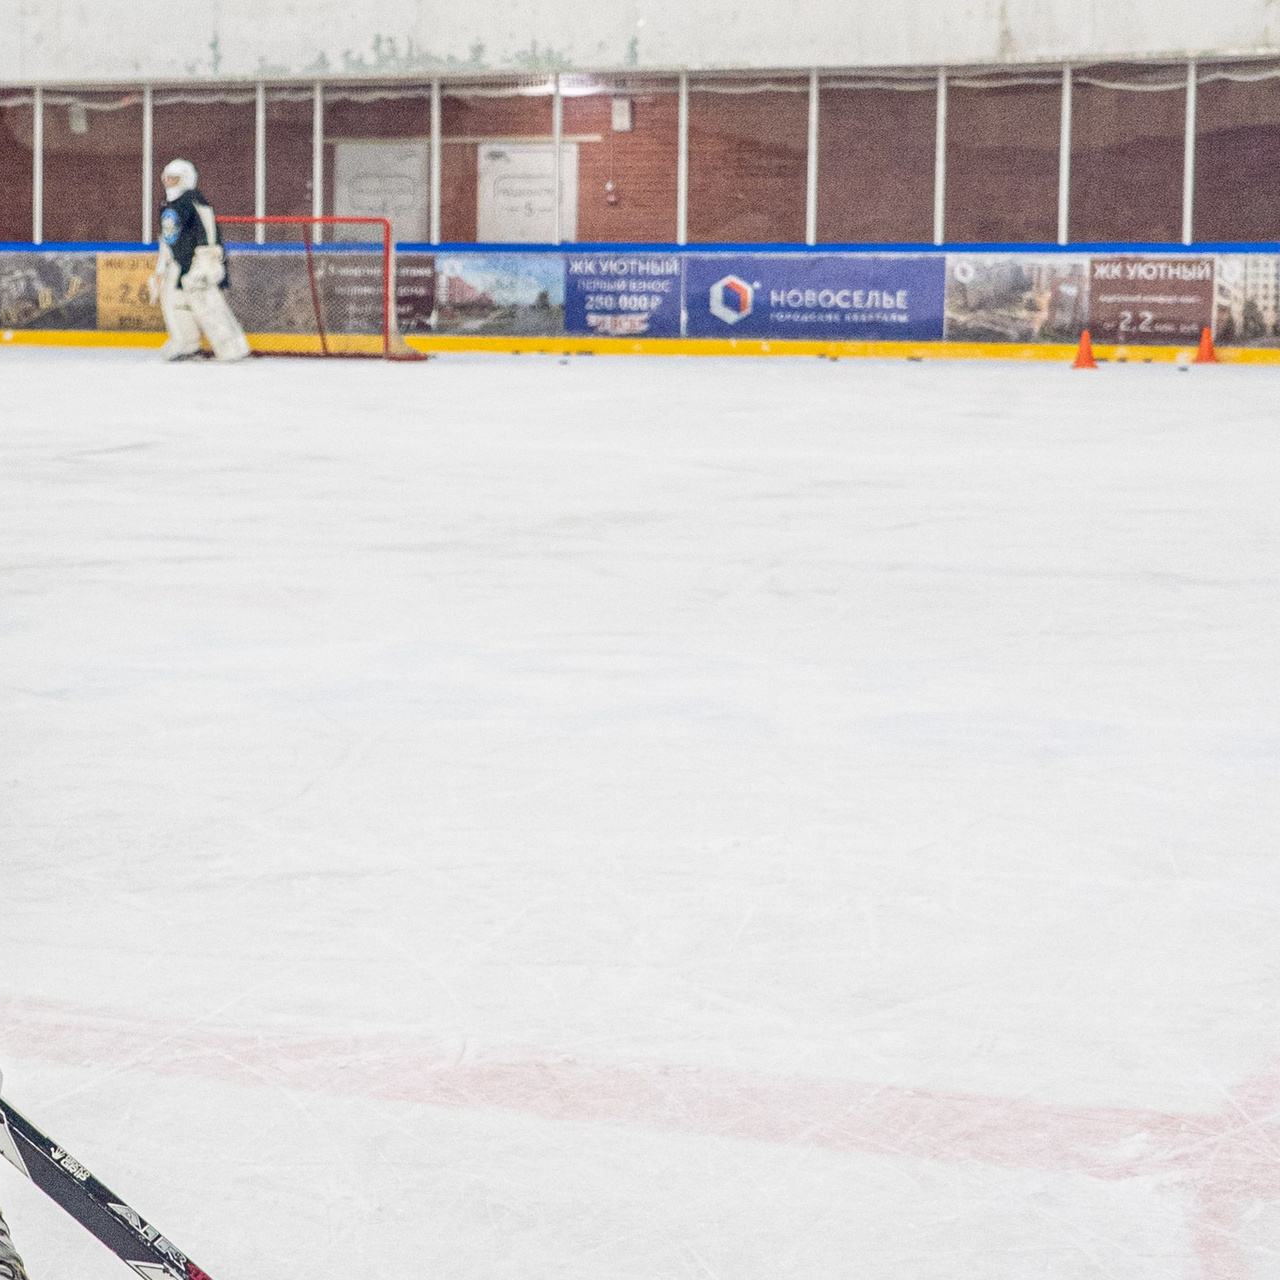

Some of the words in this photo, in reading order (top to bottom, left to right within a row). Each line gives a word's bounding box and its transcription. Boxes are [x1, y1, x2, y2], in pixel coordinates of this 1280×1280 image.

[600, 256, 680, 276] УЮТНЫЙ
[1125, 260, 1211, 280] УЮТНЫЙ
[770, 289, 908, 310] НОВОСЕЛЬЕ
[61, 1158, 88, 1182] GRIP
